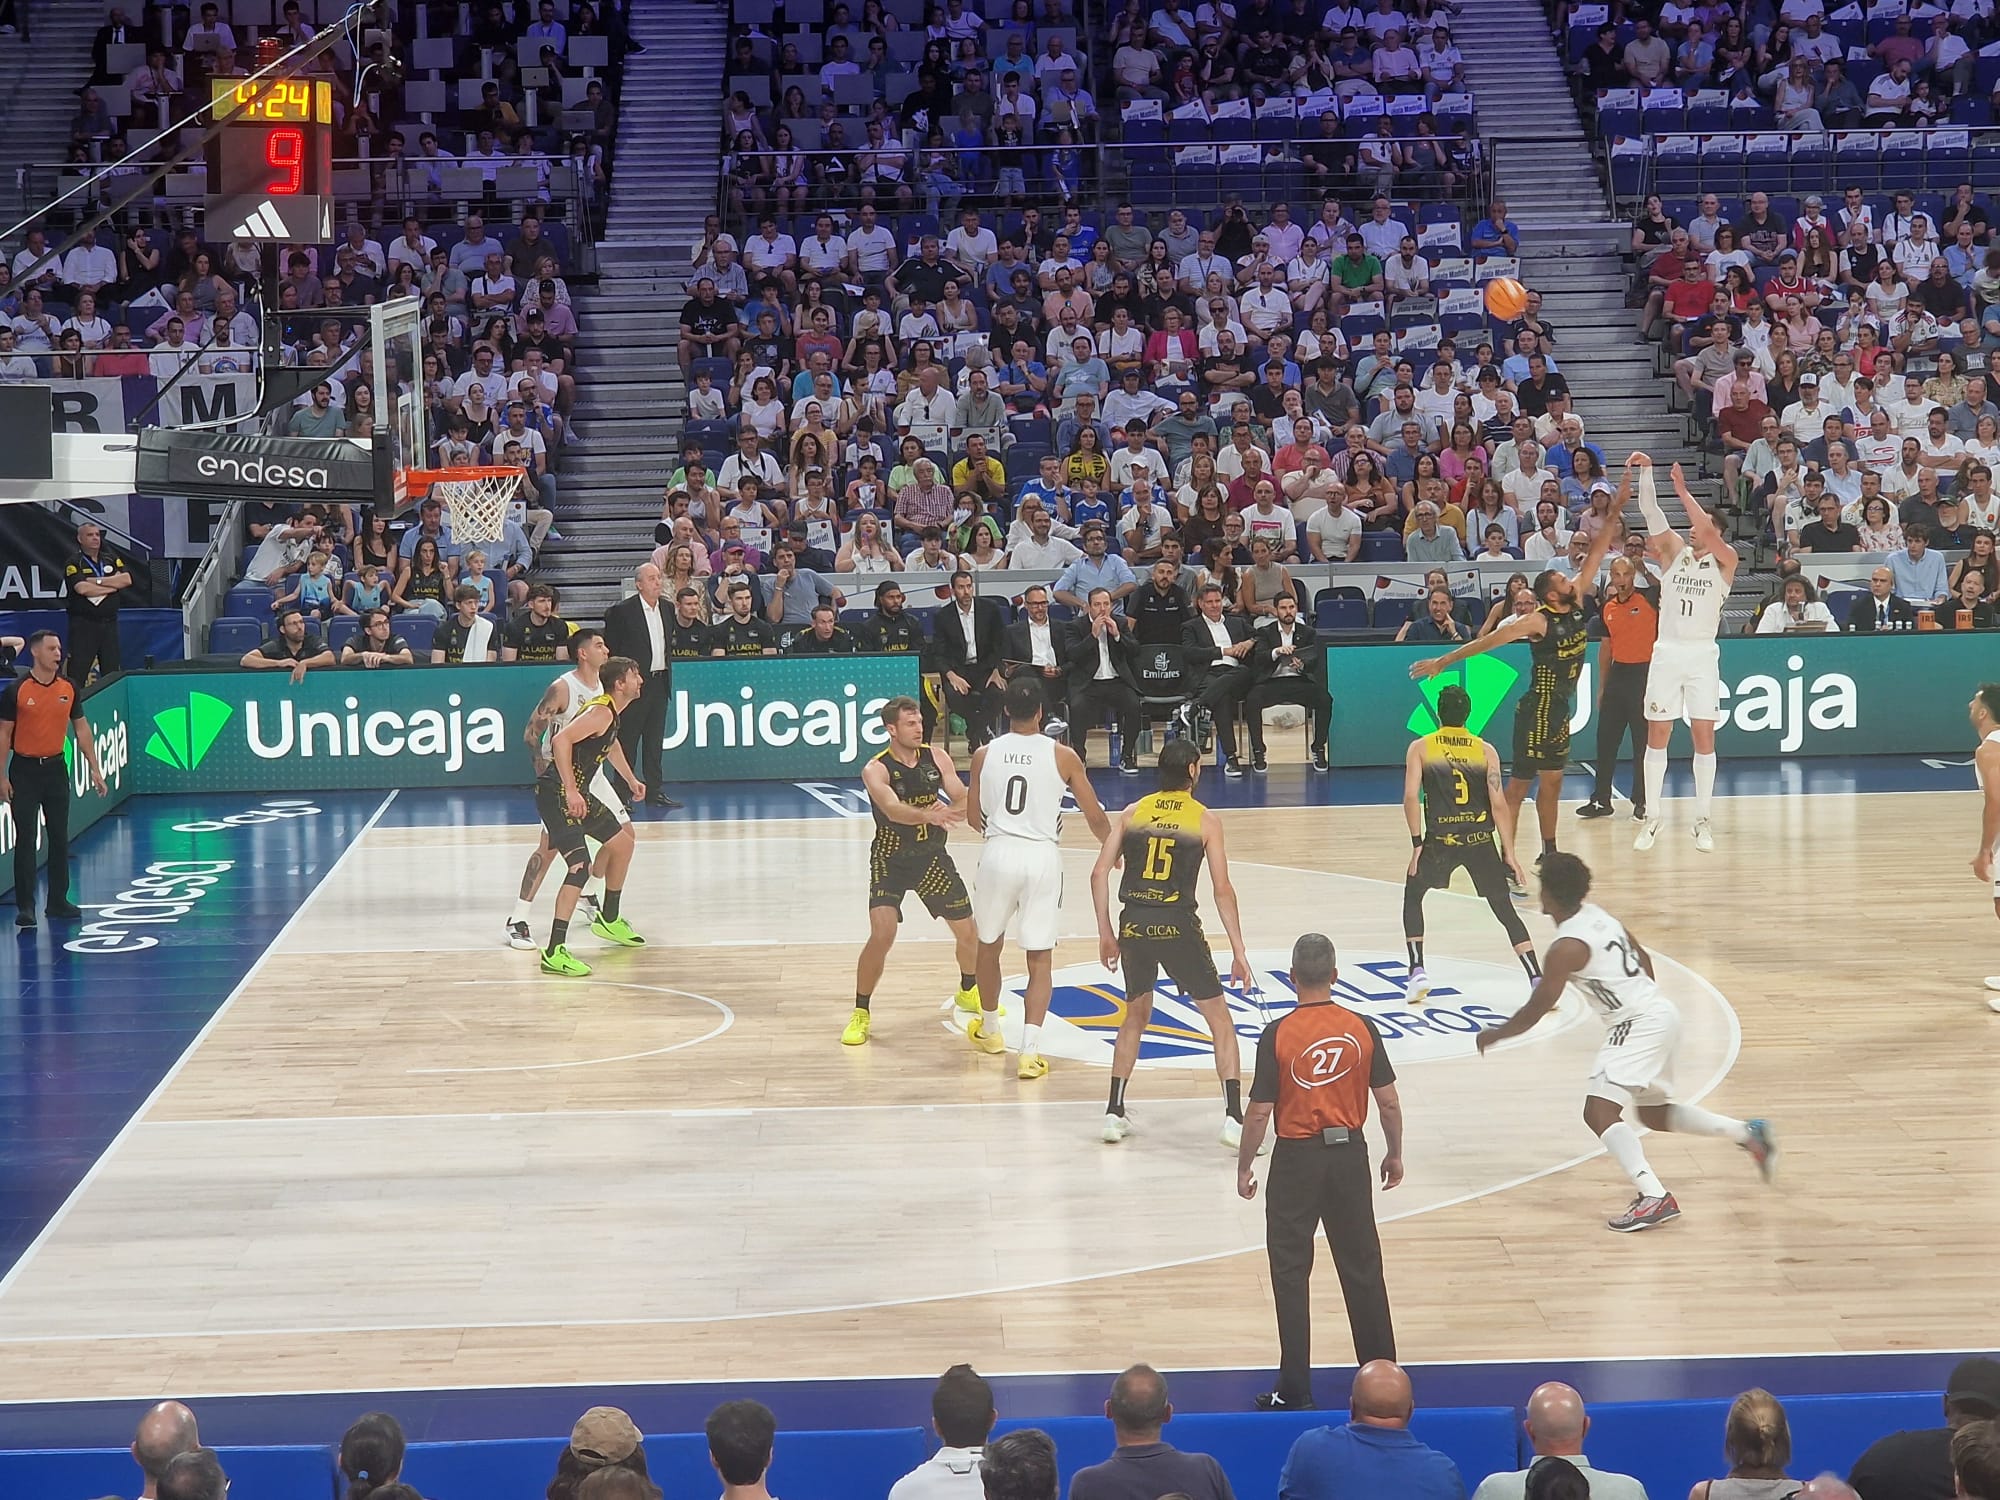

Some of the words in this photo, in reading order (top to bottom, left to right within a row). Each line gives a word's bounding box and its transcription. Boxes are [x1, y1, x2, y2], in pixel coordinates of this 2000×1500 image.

[269, 132, 302, 193] 9
[180, 383, 238, 433] M
[197, 455, 328, 489] endesa
[1672, 574, 1712, 588] Emirates
[1680, 599, 1693, 616] 11
[1142, 669, 1181, 679] Emirates
[245, 692, 506, 772] Unicaja
[1003, 752, 1032, 765] LYLES
[1005, 775, 1028, 815] 0
[1452, 768, 1469, 805] 3
[1154, 799, 1184, 811] SASTRE
[1142, 836, 1176, 881] 15
[63, 859, 236, 954] endesa
[1311, 1047, 1344, 1075] 27
